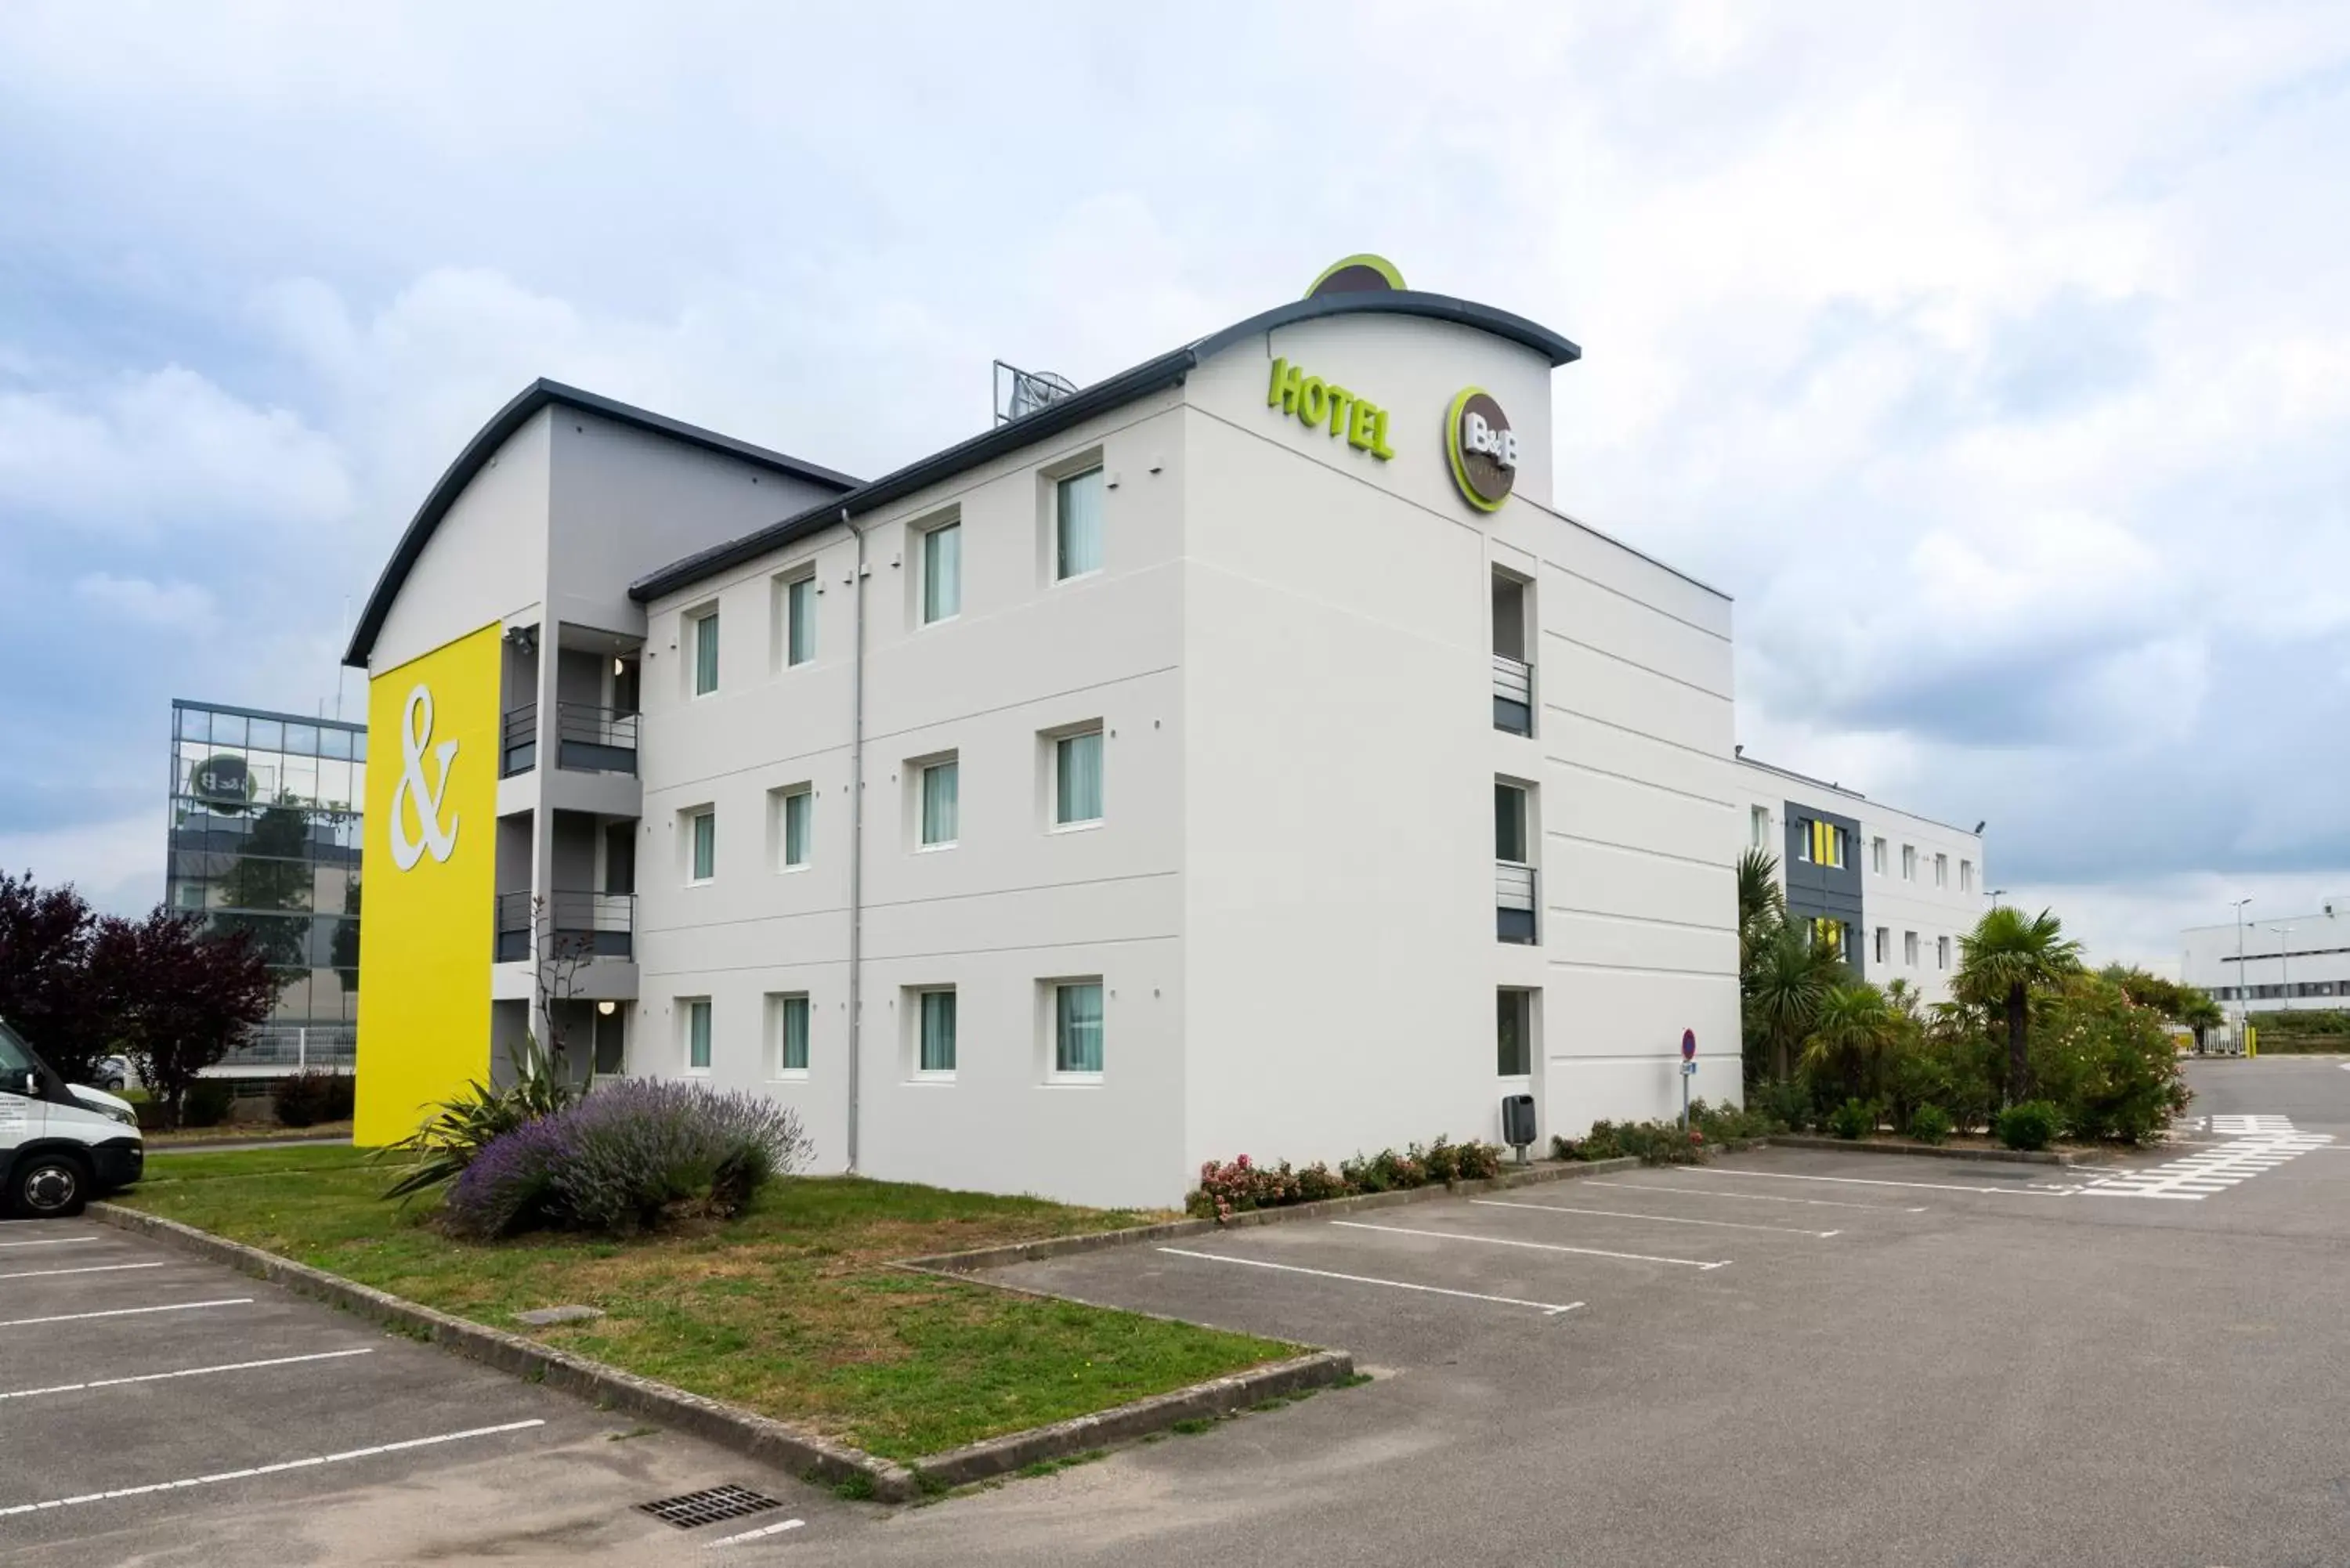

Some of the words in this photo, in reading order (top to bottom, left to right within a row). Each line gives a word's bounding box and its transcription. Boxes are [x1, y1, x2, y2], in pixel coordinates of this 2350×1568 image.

[1267, 357, 1394, 461] HOTEL
[1465, 412, 1518, 469] B&B
[390, 684, 460, 872] &
